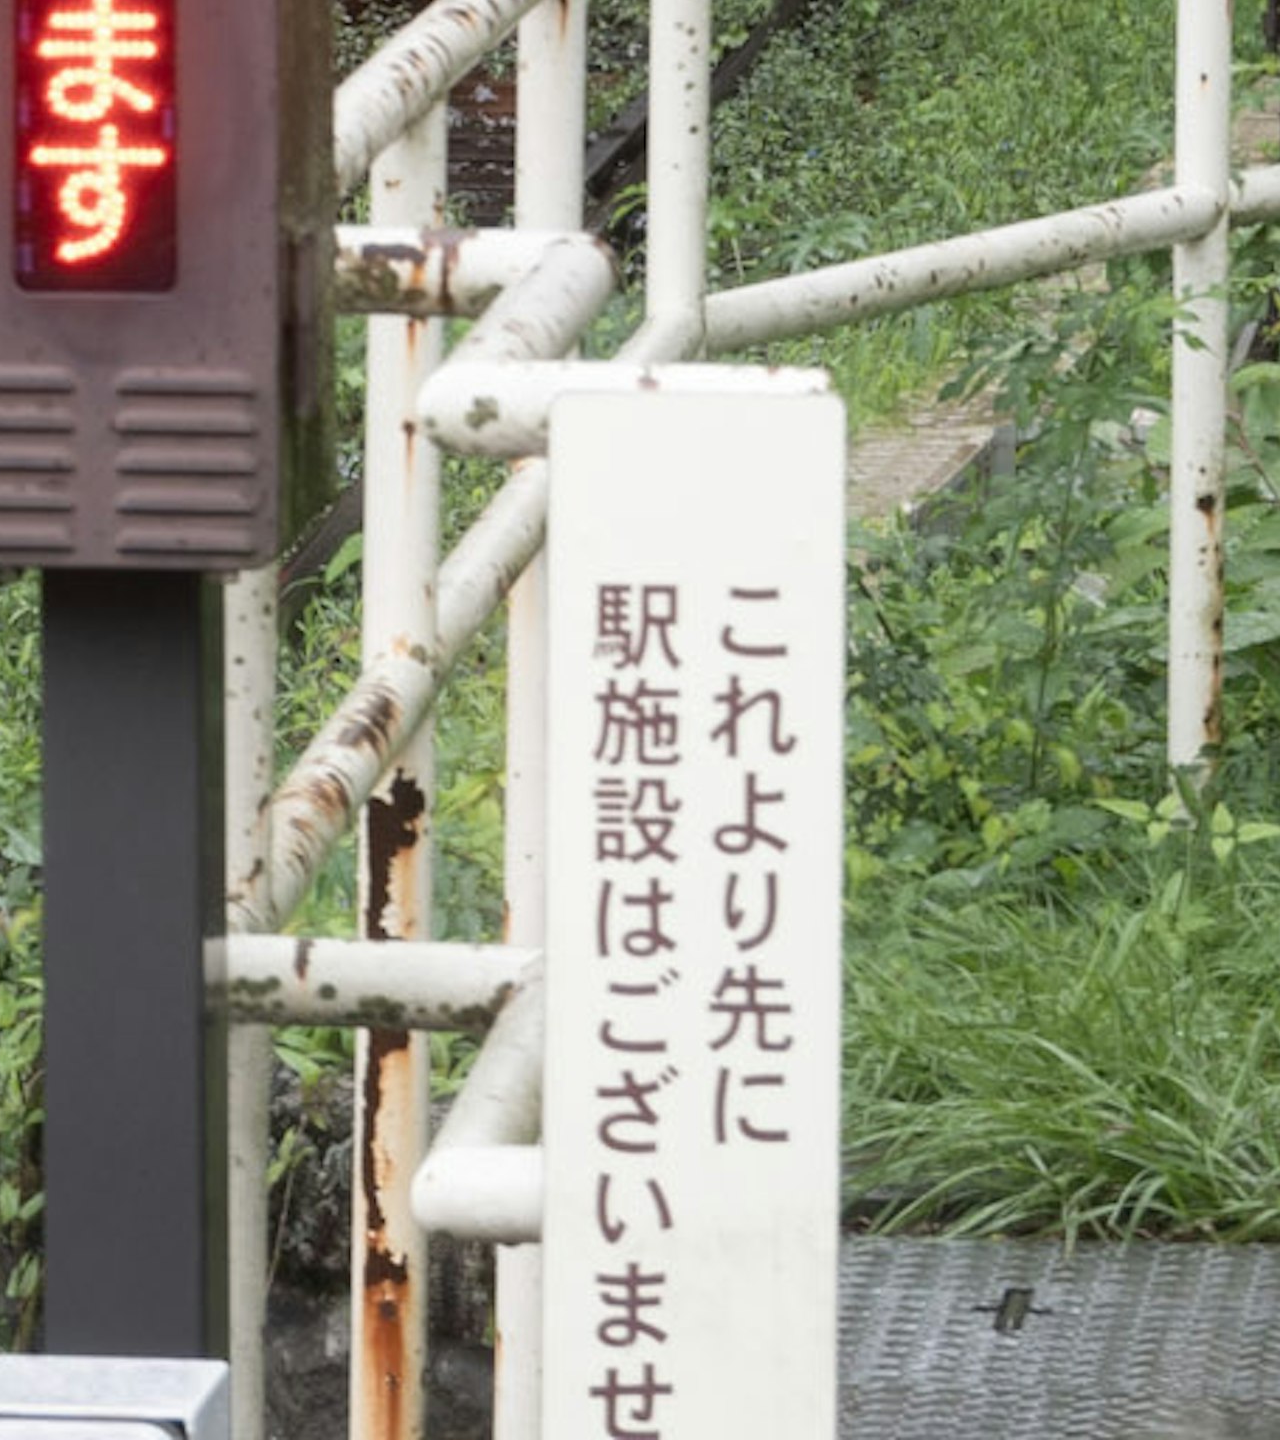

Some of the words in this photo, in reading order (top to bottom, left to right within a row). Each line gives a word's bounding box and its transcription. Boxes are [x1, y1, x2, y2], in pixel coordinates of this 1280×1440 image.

[591, 583, 682, 1440] 駅施設はございませ
[709, 583, 798, 1147] これより先に
